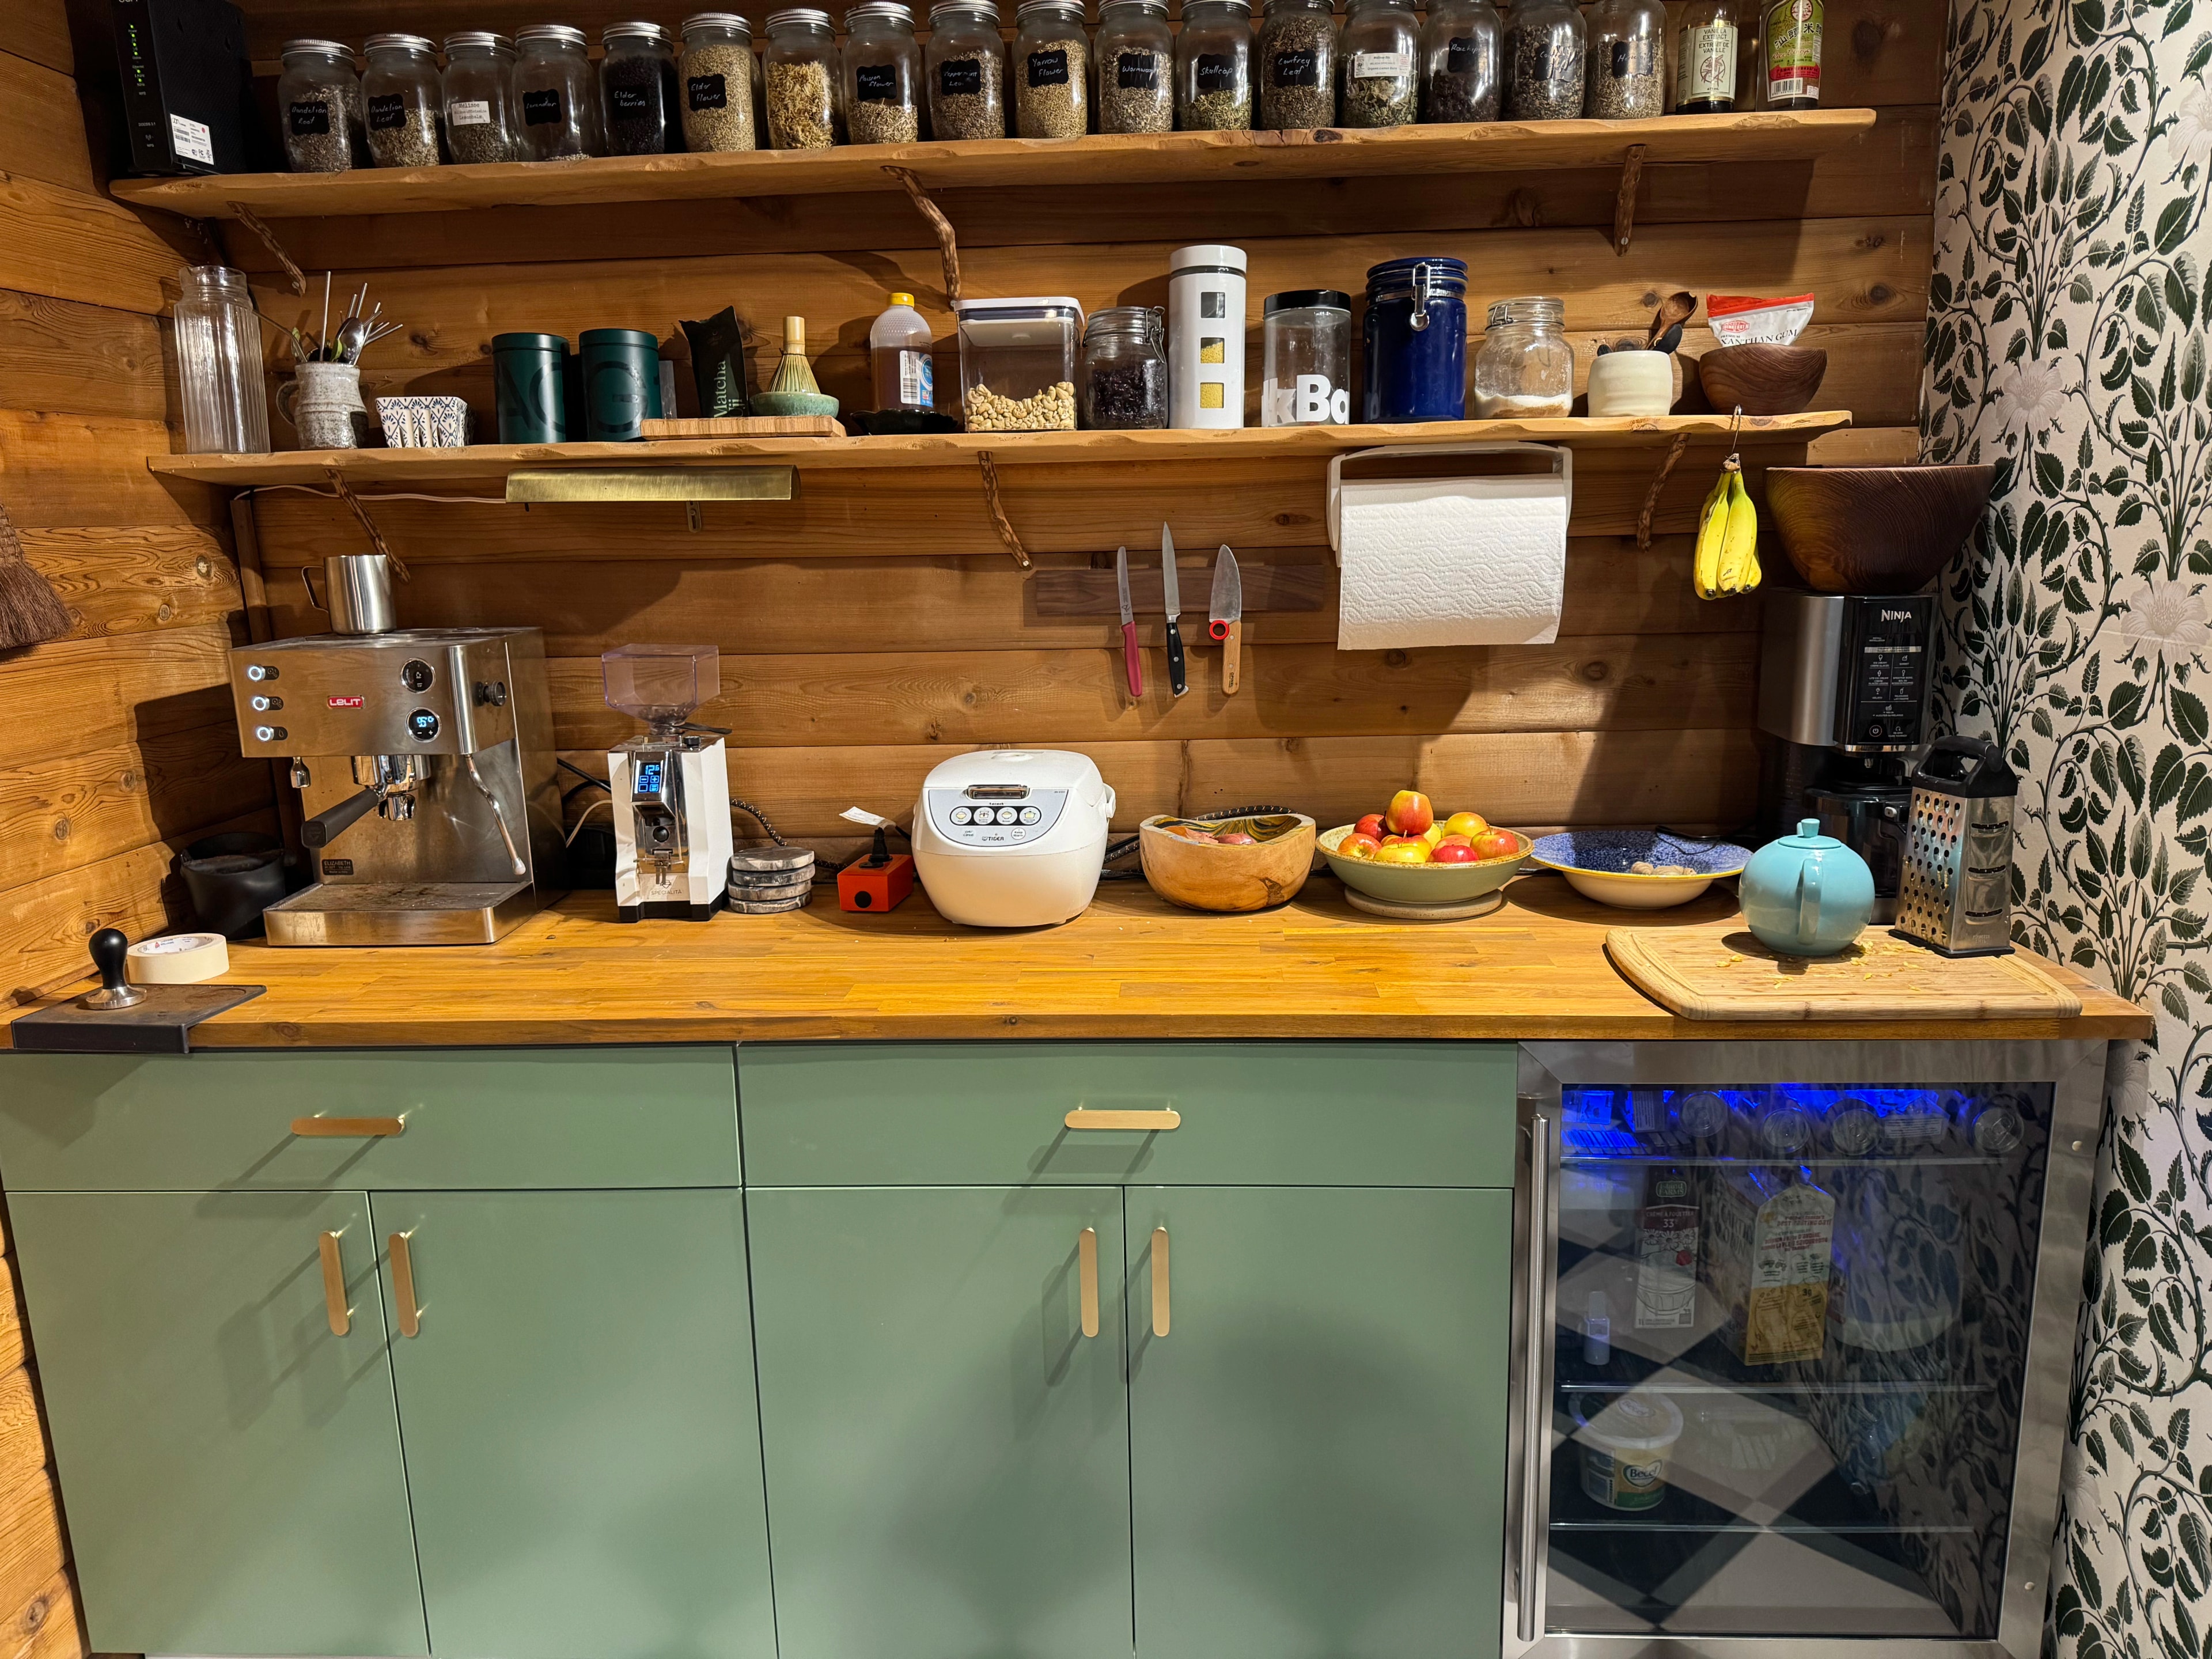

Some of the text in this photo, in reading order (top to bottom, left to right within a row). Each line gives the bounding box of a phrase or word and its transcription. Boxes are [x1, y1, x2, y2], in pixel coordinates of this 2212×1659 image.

[1032, 58, 1059, 67] Yarrow
[1199, 65, 1233, 77] Skullcap
[1283, 66, 1304, 75] Leaf
[691, 83, 711, 91] Elder
[371, 102, 403, 113] Dandelion
[376, 113, 395, 122] Leaf
[1775, 329, 1798, 341] GUM
[713, 359, 728, 418] Matcha
[1262, 374, 1350, 427] lkBa
[1881, 609, 1912, 623] NINJA
[1630, 1464, 1658, 1478] Becel
